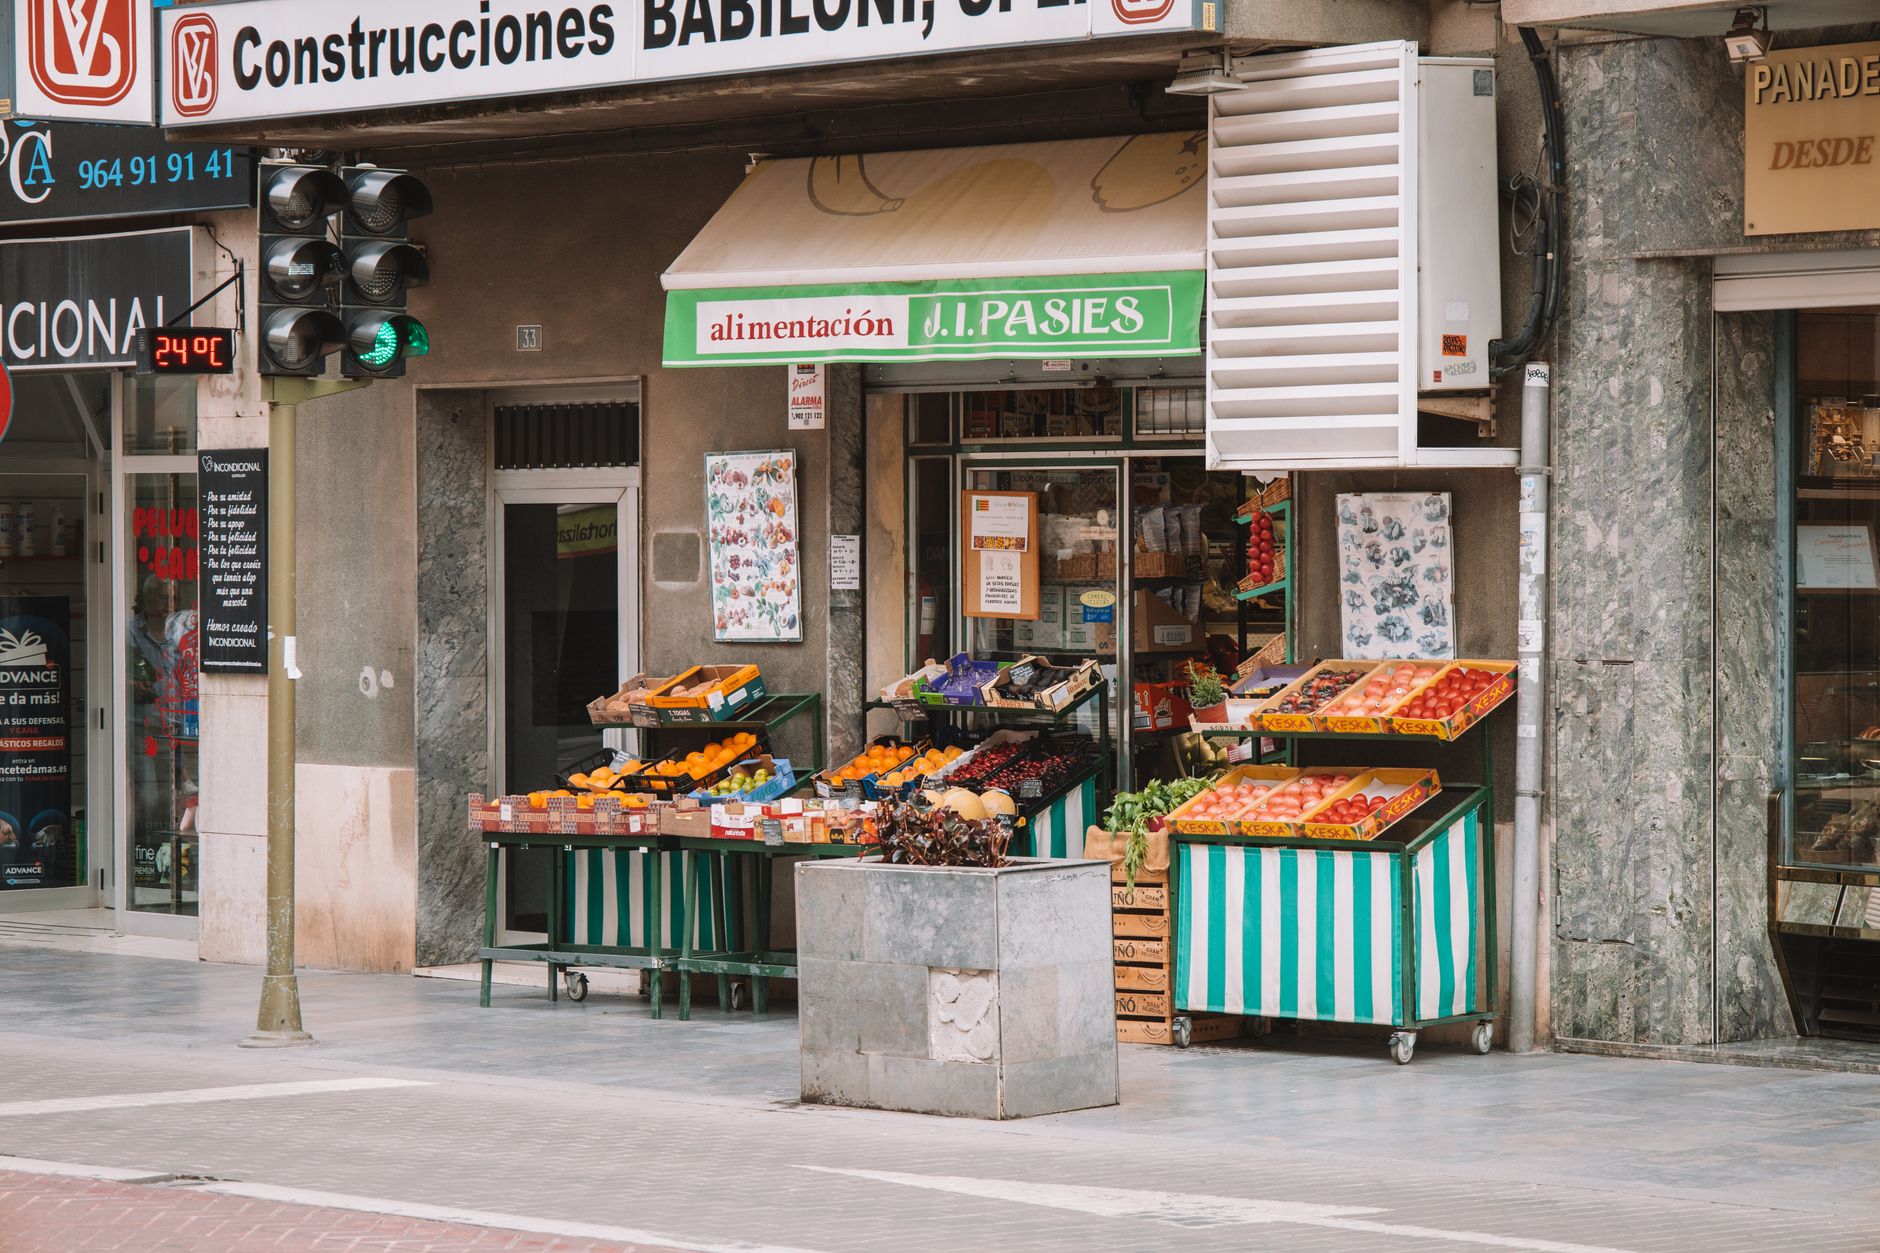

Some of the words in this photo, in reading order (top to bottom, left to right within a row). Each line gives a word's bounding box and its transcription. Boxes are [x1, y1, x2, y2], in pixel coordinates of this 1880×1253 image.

[232, 1, 614, 91] Construcciones
[1768, 136, 1875, 171] DESDE
[78, 158, 123, 189] 964
[130, 154, 157, 186] 91
[167, 152, 194, 182] 91
[205, 149, 233, 179] 41
[710, 308, 894, 342] alimentación
[523, 329, 537, 348] 33
[791, 396, 823, 406] ALARMA
[213, 462, 261, 473] INCONDICIONAL
[227, 504, 257, 517] fidelidad
[227, 531, 257, 544] felicidad
[227, 544, 257, 557] felicidad
[242, 572, 256, 585] algo
[222, 597, 247, 607] mascota
[206, 619, 230, 632] Hemos
[231, 621, 258, 633] creado
[208, 636, 257, 647] INCONDICIONAL
[0, 671, 58, 683] DVANCE
[9, 692, 26, 705] da
[30, 692, 60, 705] más!
[1474, 681, 1510, 713] XESKA
[1266, 717, 1307, 730] XESKA
[1331, 717, 1373, 731] XESKA
[1396, 721, 1440, 734] XESKA
[32, 739, 64, 747] REGALOS
[1386, 787, 1421, 819] XESKA
[1180, 822, 1221, 835] XESKA
[1241, 823, 1286, 836] XESKA
[1310, 825, 1350, 838] XESKA
[5, 866, 43, 875] ADVANCE
